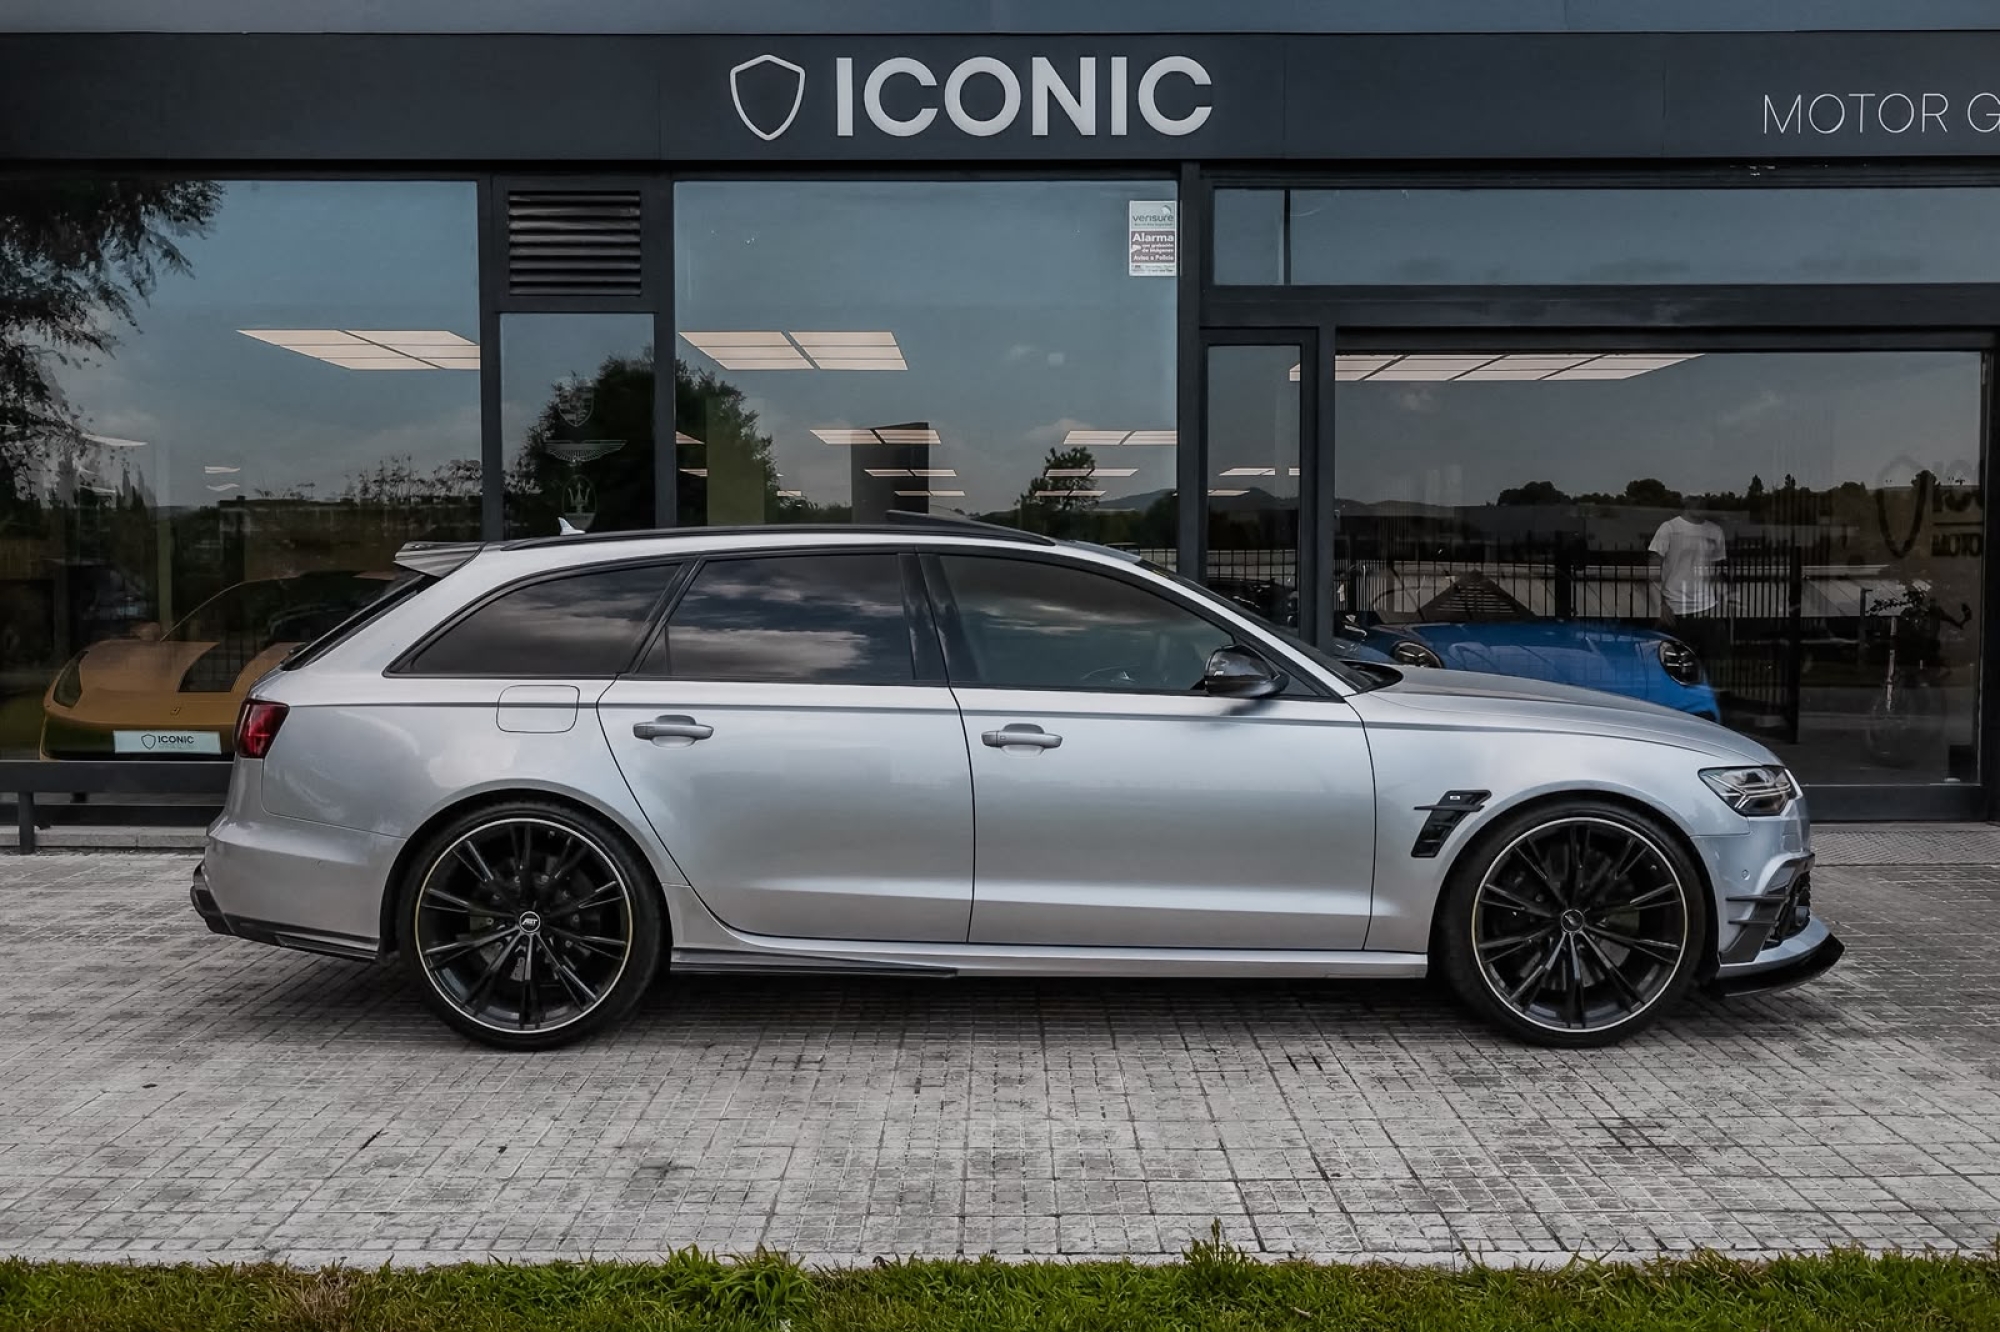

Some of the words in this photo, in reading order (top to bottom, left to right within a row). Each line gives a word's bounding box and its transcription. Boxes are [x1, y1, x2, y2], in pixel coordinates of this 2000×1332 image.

[837, 56, 1212, 137] ICONIC
[1763, 93, 1949, 134] MOTOR
[1132, 214, 1174, 222] verisure
[1132, 232, 1174, 242] Alarma
[158, 735, 194, 744] ICONIC
